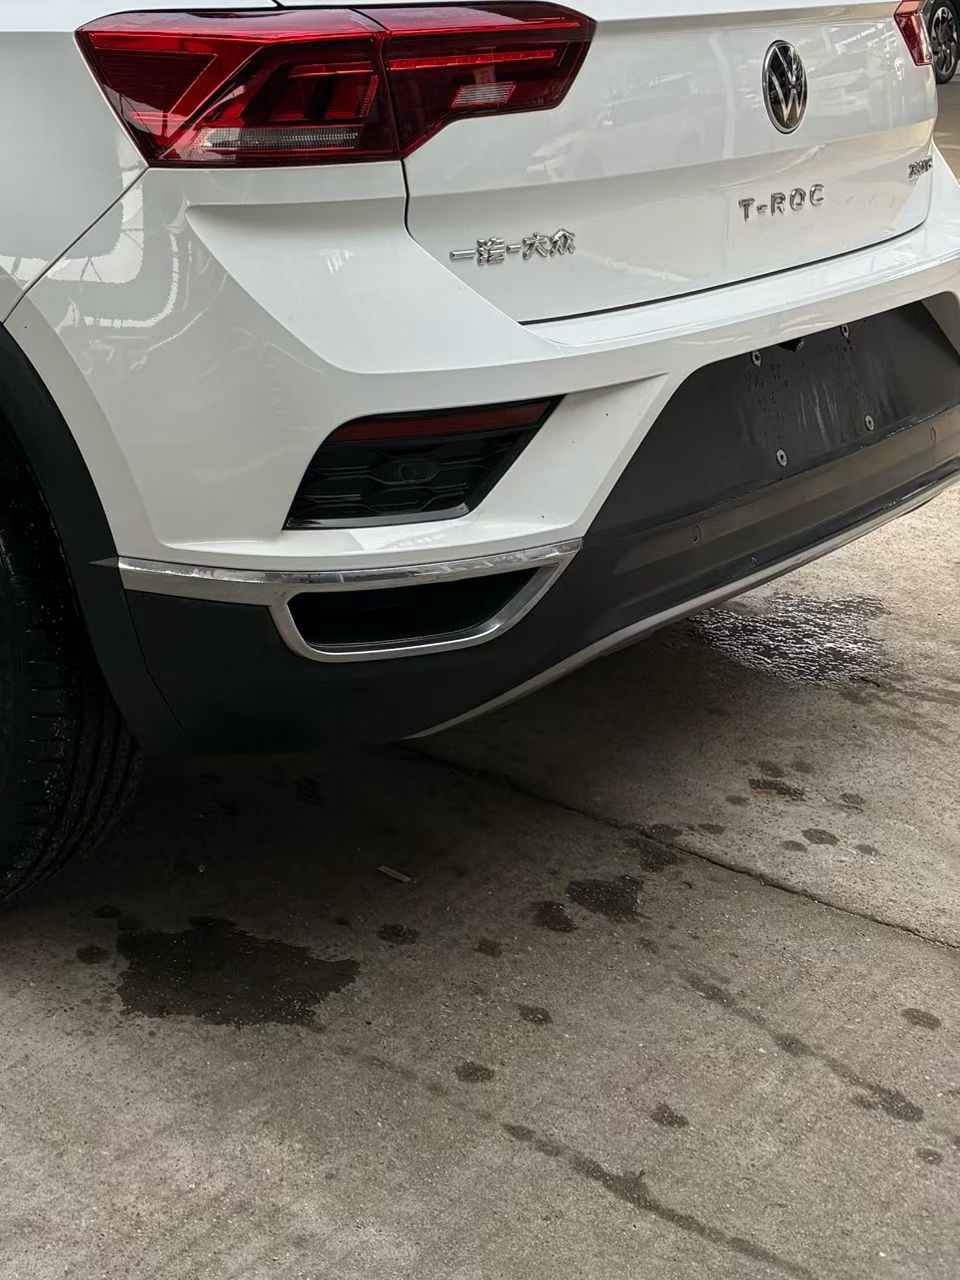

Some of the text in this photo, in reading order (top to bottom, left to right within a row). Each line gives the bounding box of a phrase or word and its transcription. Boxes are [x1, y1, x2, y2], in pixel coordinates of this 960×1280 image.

[738, 183, 825, 222] T-ROC
[449, 228, 576, 266] 一汽-大众
